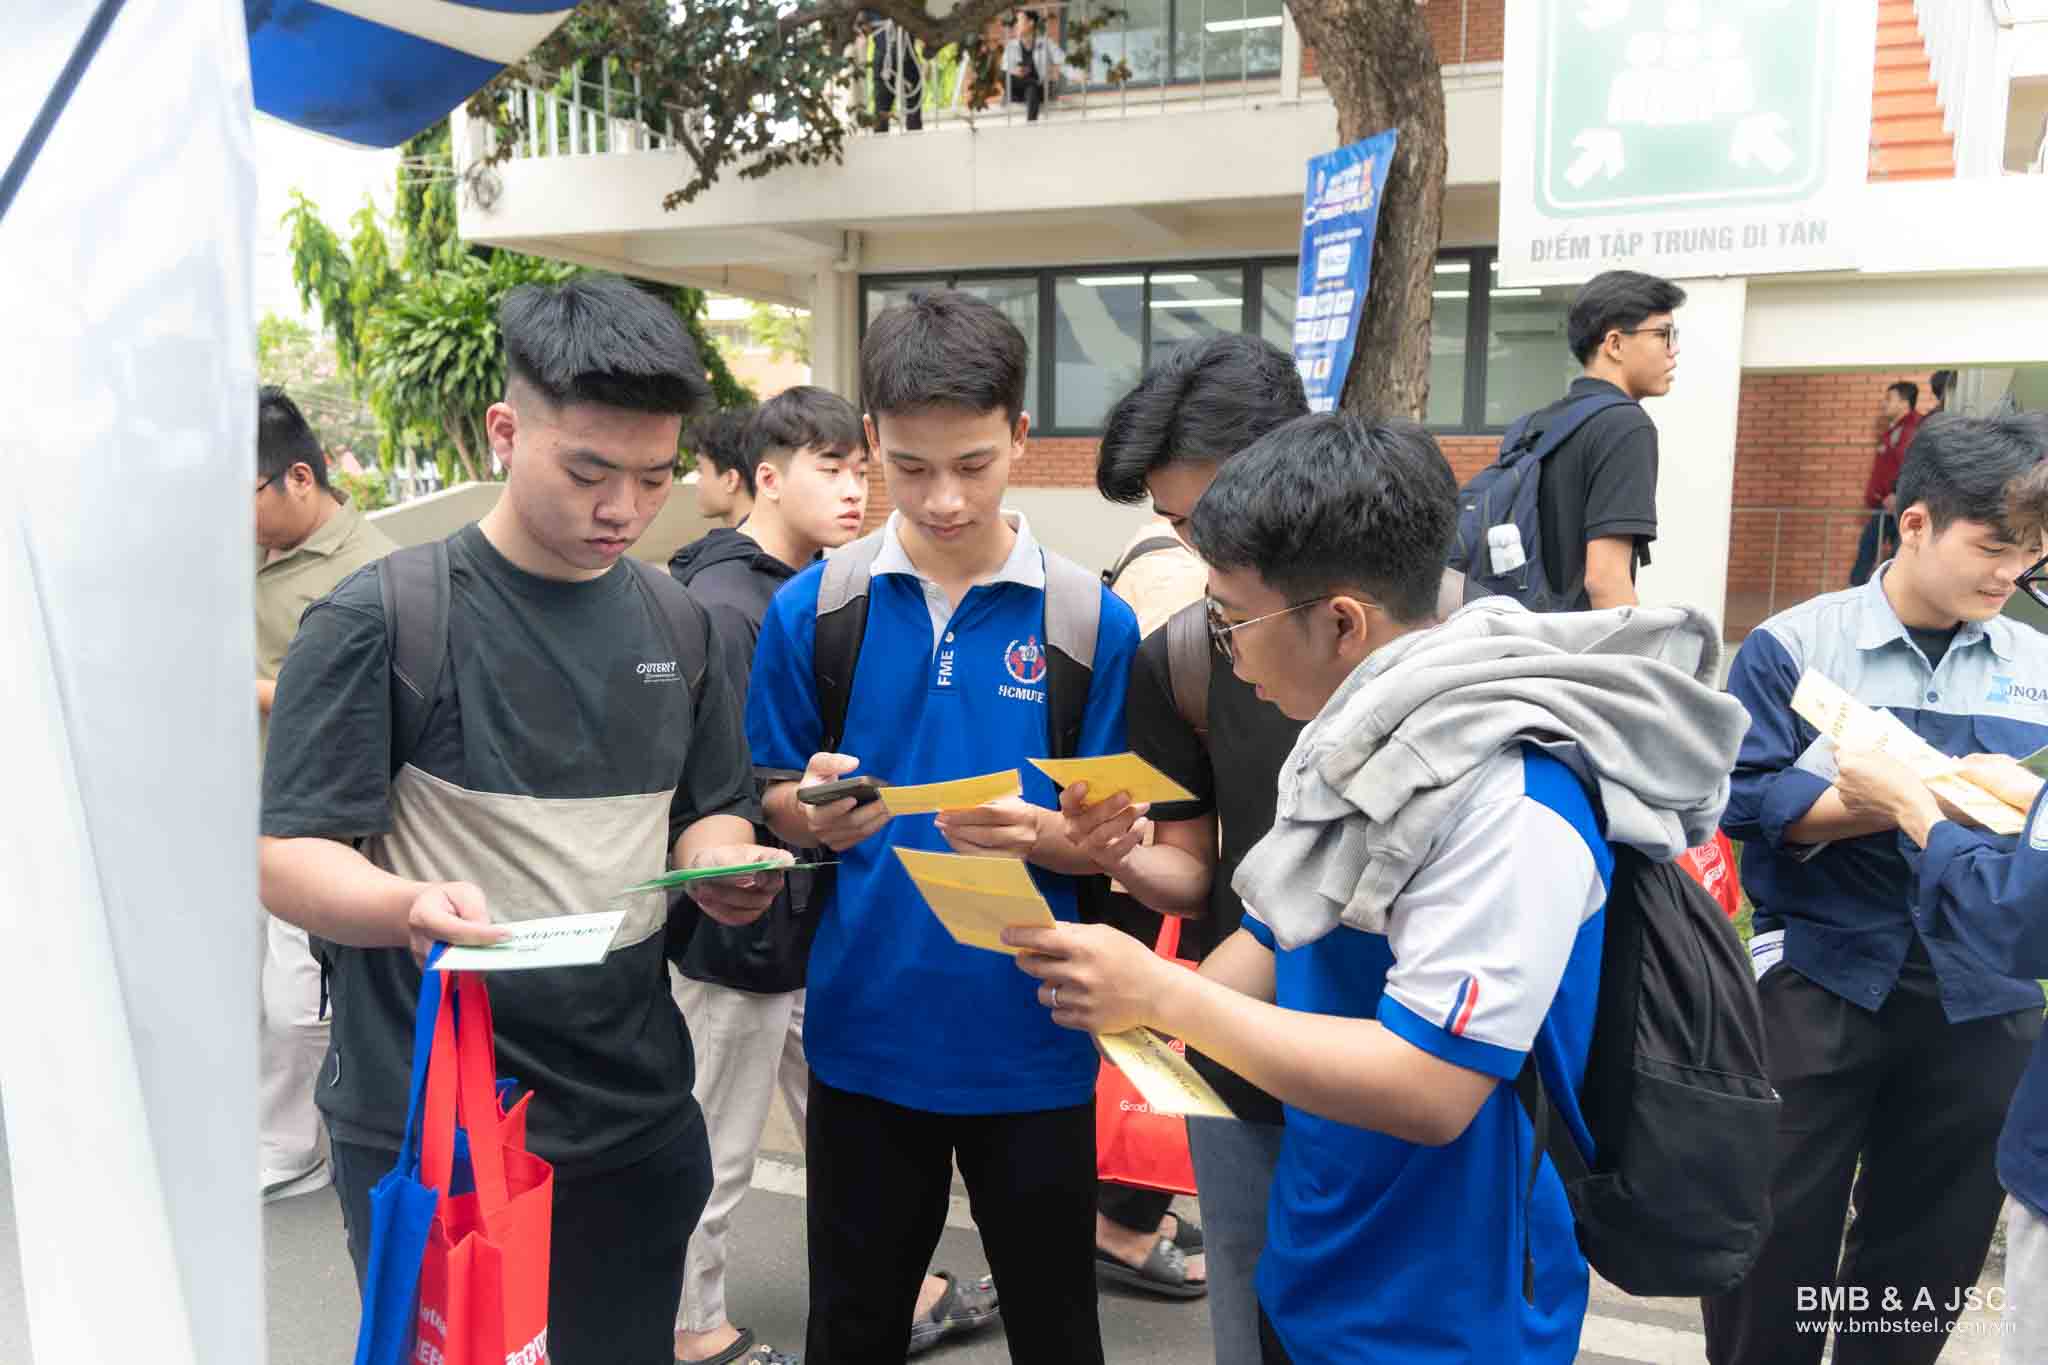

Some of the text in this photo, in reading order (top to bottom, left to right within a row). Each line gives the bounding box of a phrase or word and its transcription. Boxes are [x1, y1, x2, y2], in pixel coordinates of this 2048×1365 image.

[1653, 226, 1733, 254] TRUNG
[937, 650, 954, 686] FME
[998, 684, 1045, 704] HCMUTE
